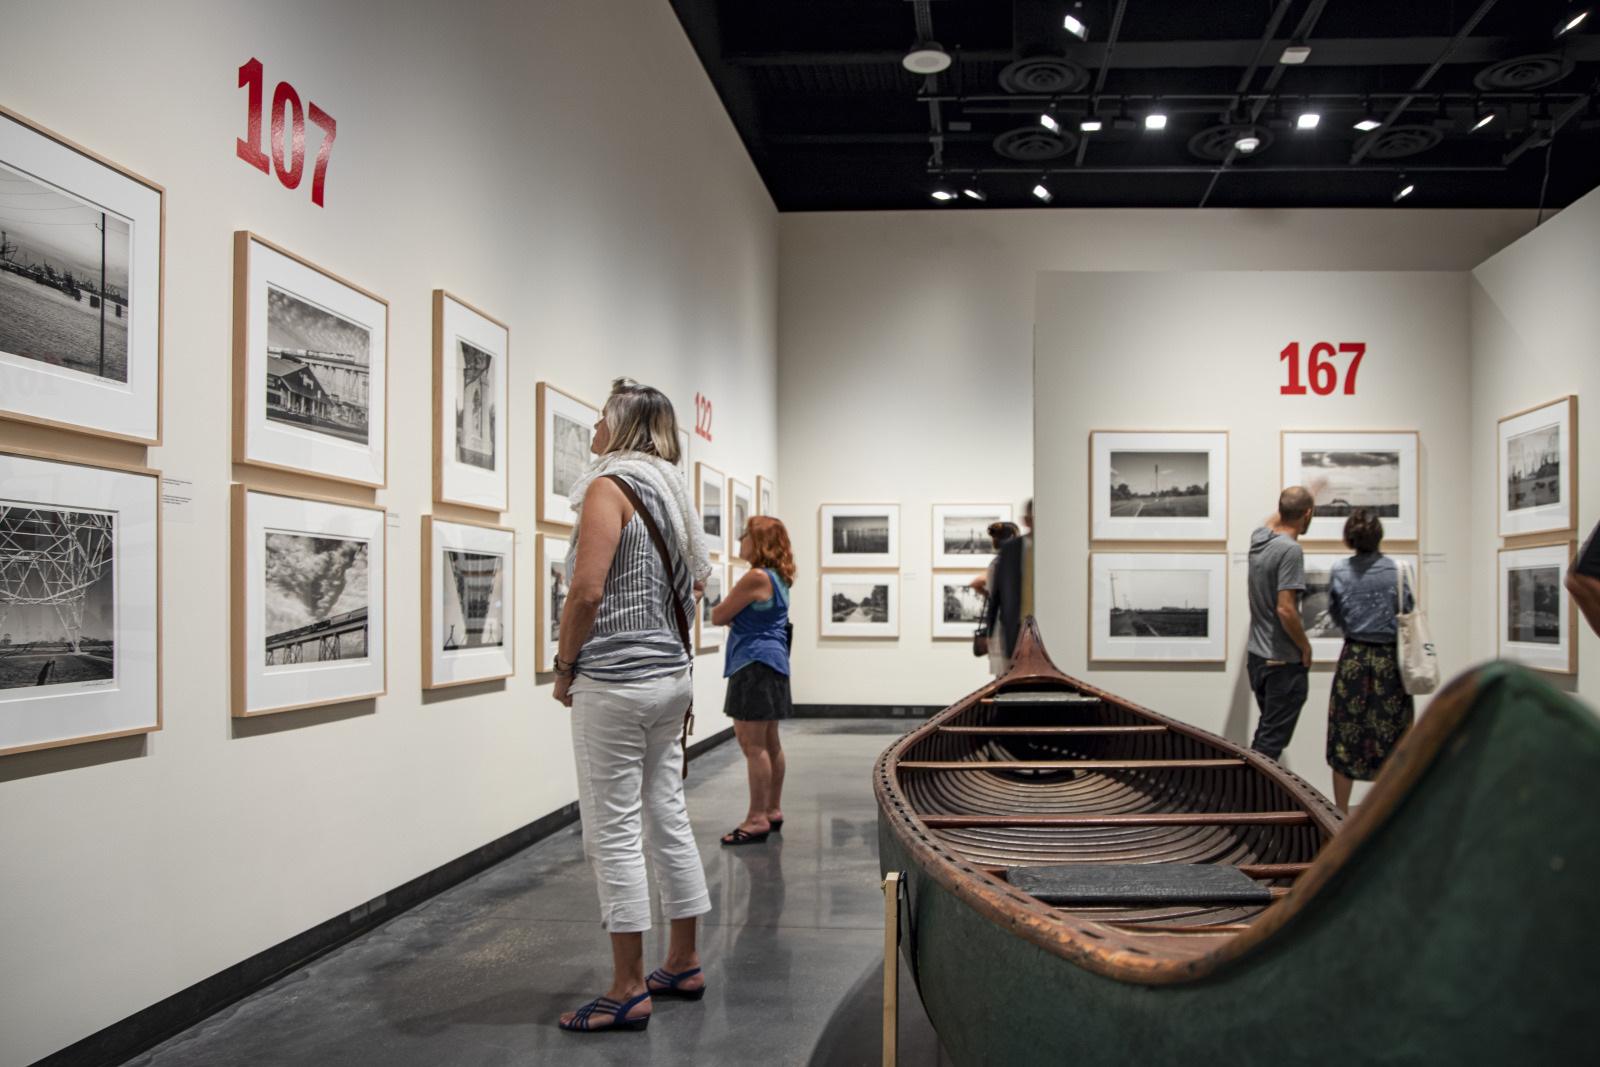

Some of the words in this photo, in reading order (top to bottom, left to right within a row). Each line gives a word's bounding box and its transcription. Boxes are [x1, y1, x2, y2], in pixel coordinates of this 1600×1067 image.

[237, 57, 336, 208] 107
[1280, 341, 1366, 396] 167
[695, 391, 713, 443] 122
